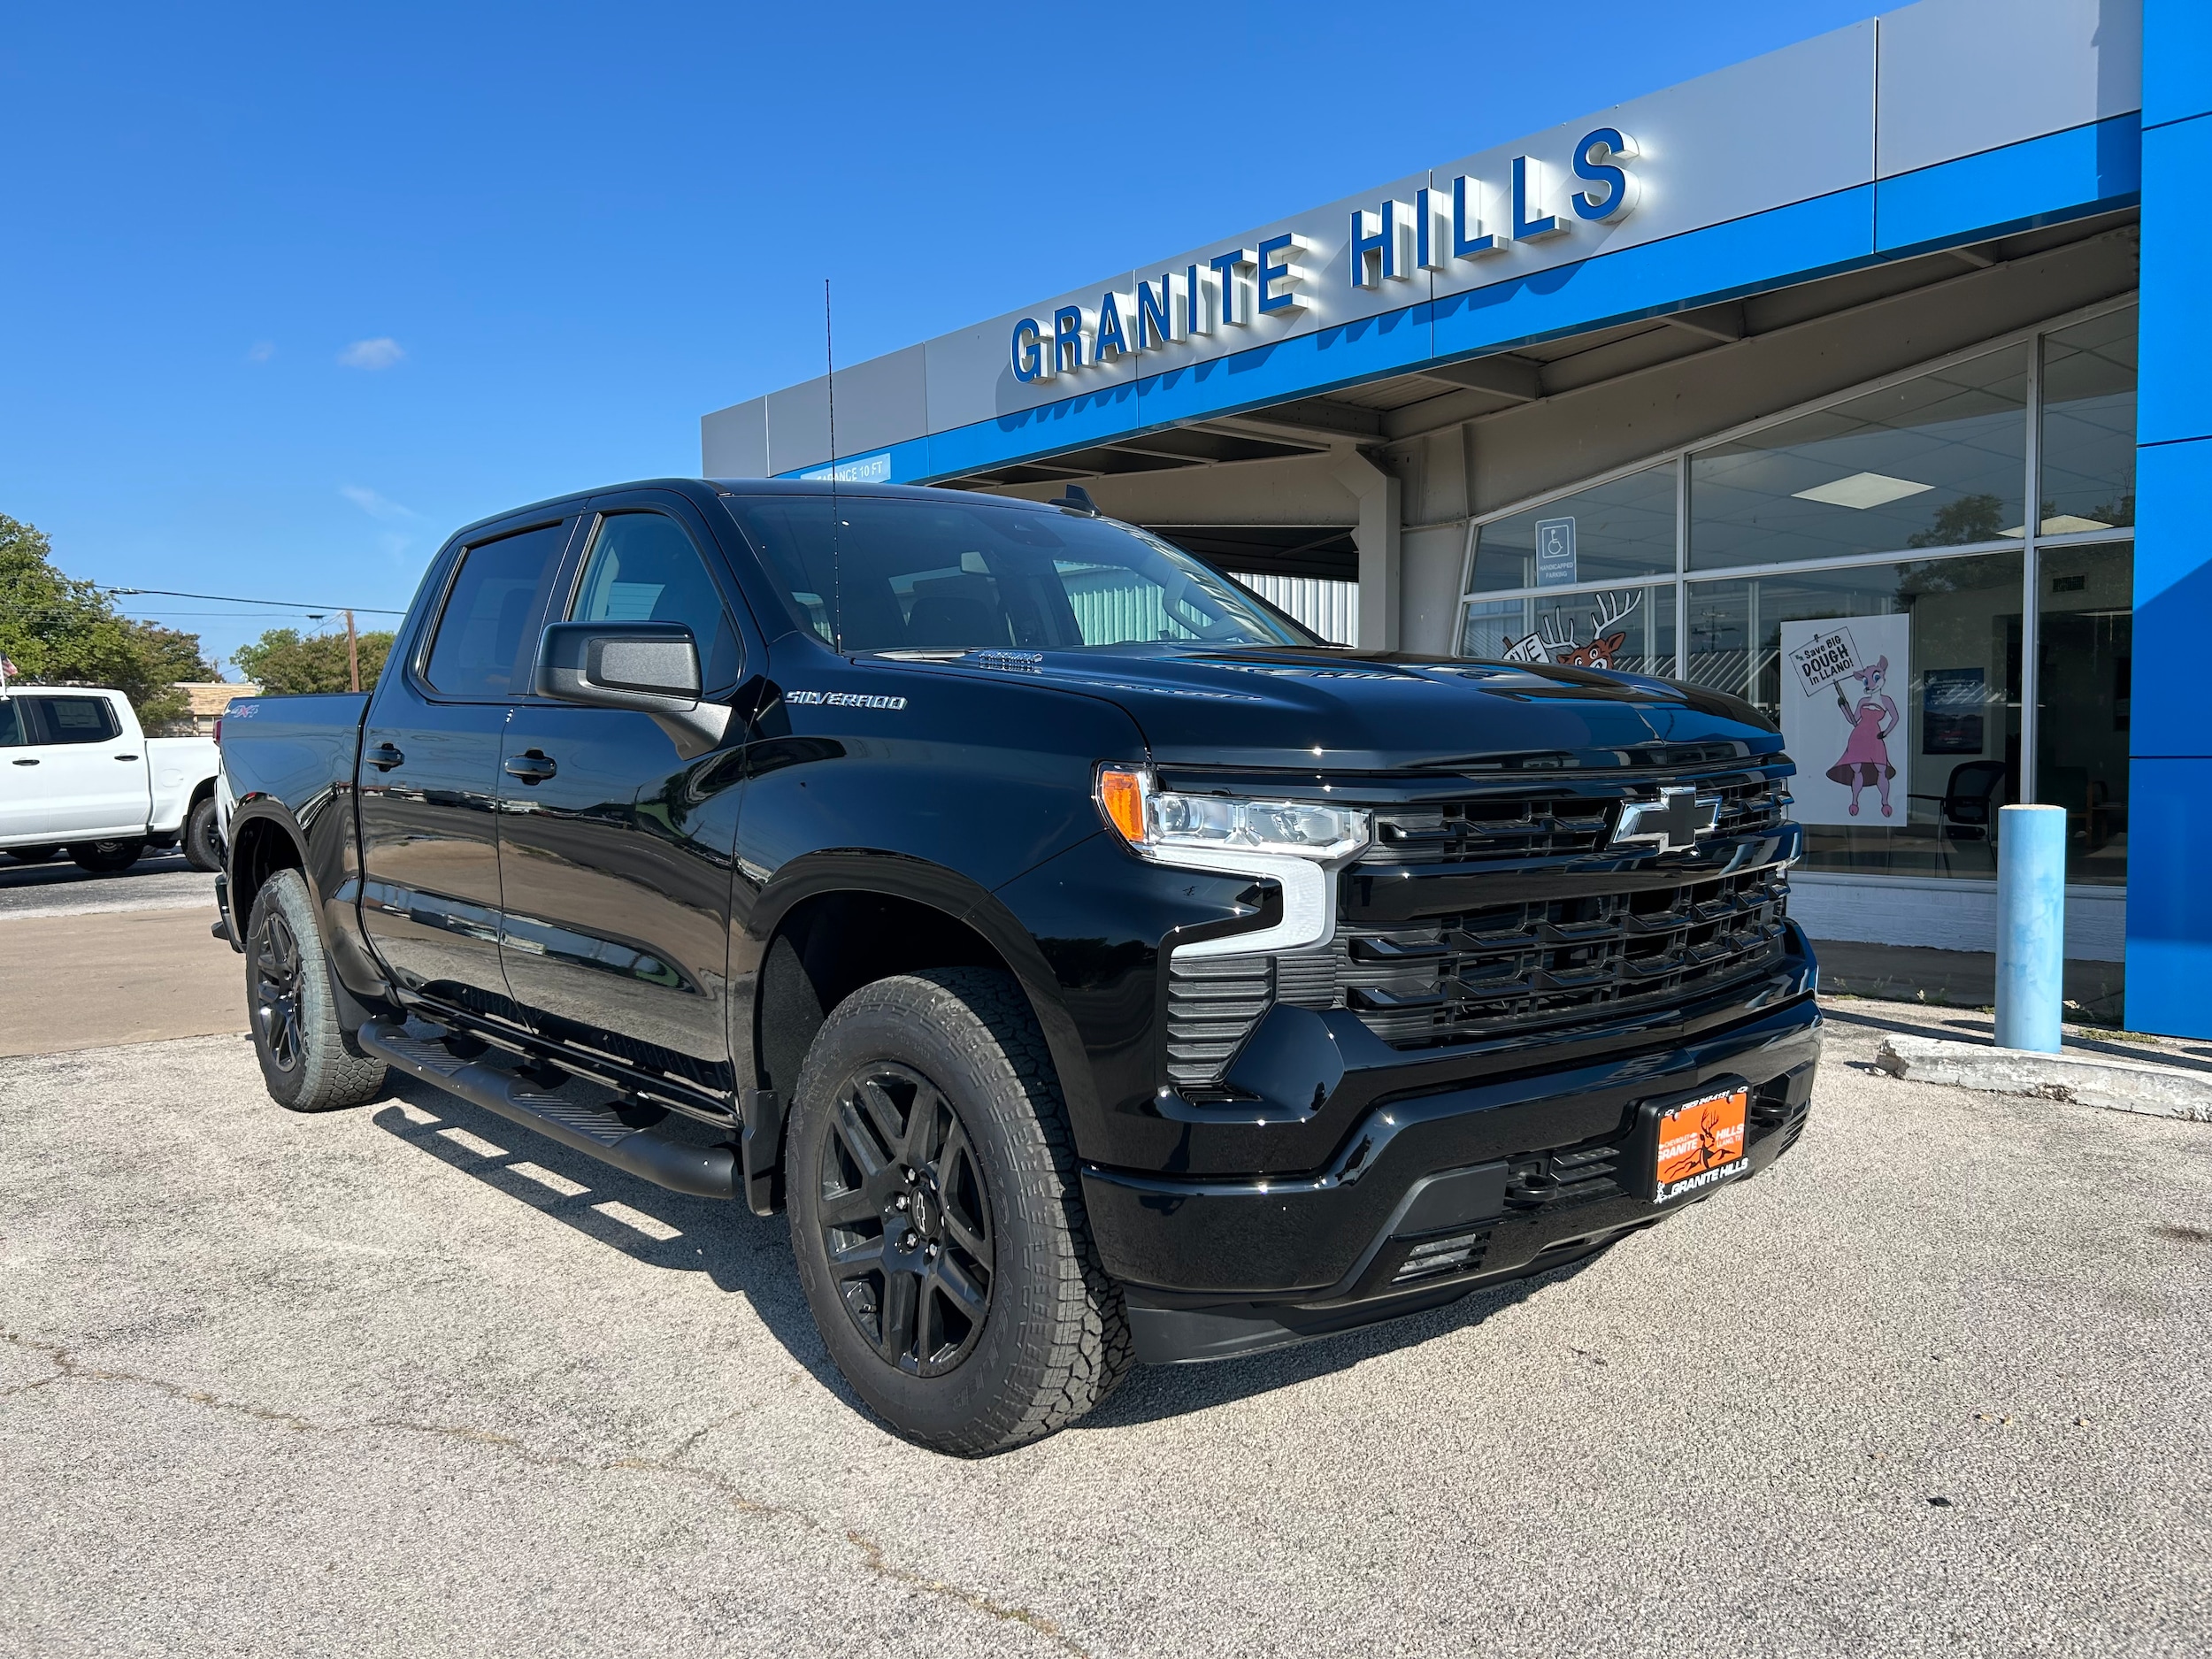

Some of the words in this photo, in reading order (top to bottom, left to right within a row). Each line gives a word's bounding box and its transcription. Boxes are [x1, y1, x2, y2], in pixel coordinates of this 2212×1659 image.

[1010, 232, 1309, 385] GRANITE
[1350, 127, 1640, 289] HILLS
[860, 465, 870, 478] 10
[872, 461, 883, 475] FT
[1540, 562, 1573, 572] HANDICAPPED
[1804, 645, 1825, 659] Save
[1825, 635, 1841, 649] BIG
[1801, 644, 1849, 677] DOUGH
[1819, 657, 1855, 680] LLANO!
[785, 690, 908, 710] SILVERADO
[1664, 1134, 1690, 1148] CHEVROLET
[1716, 1124, 1745, 1141] HILLS
[1671, 1169, 1719, 1196] GRANITE
[1719, 1157, 1749, 1179] HILLS
